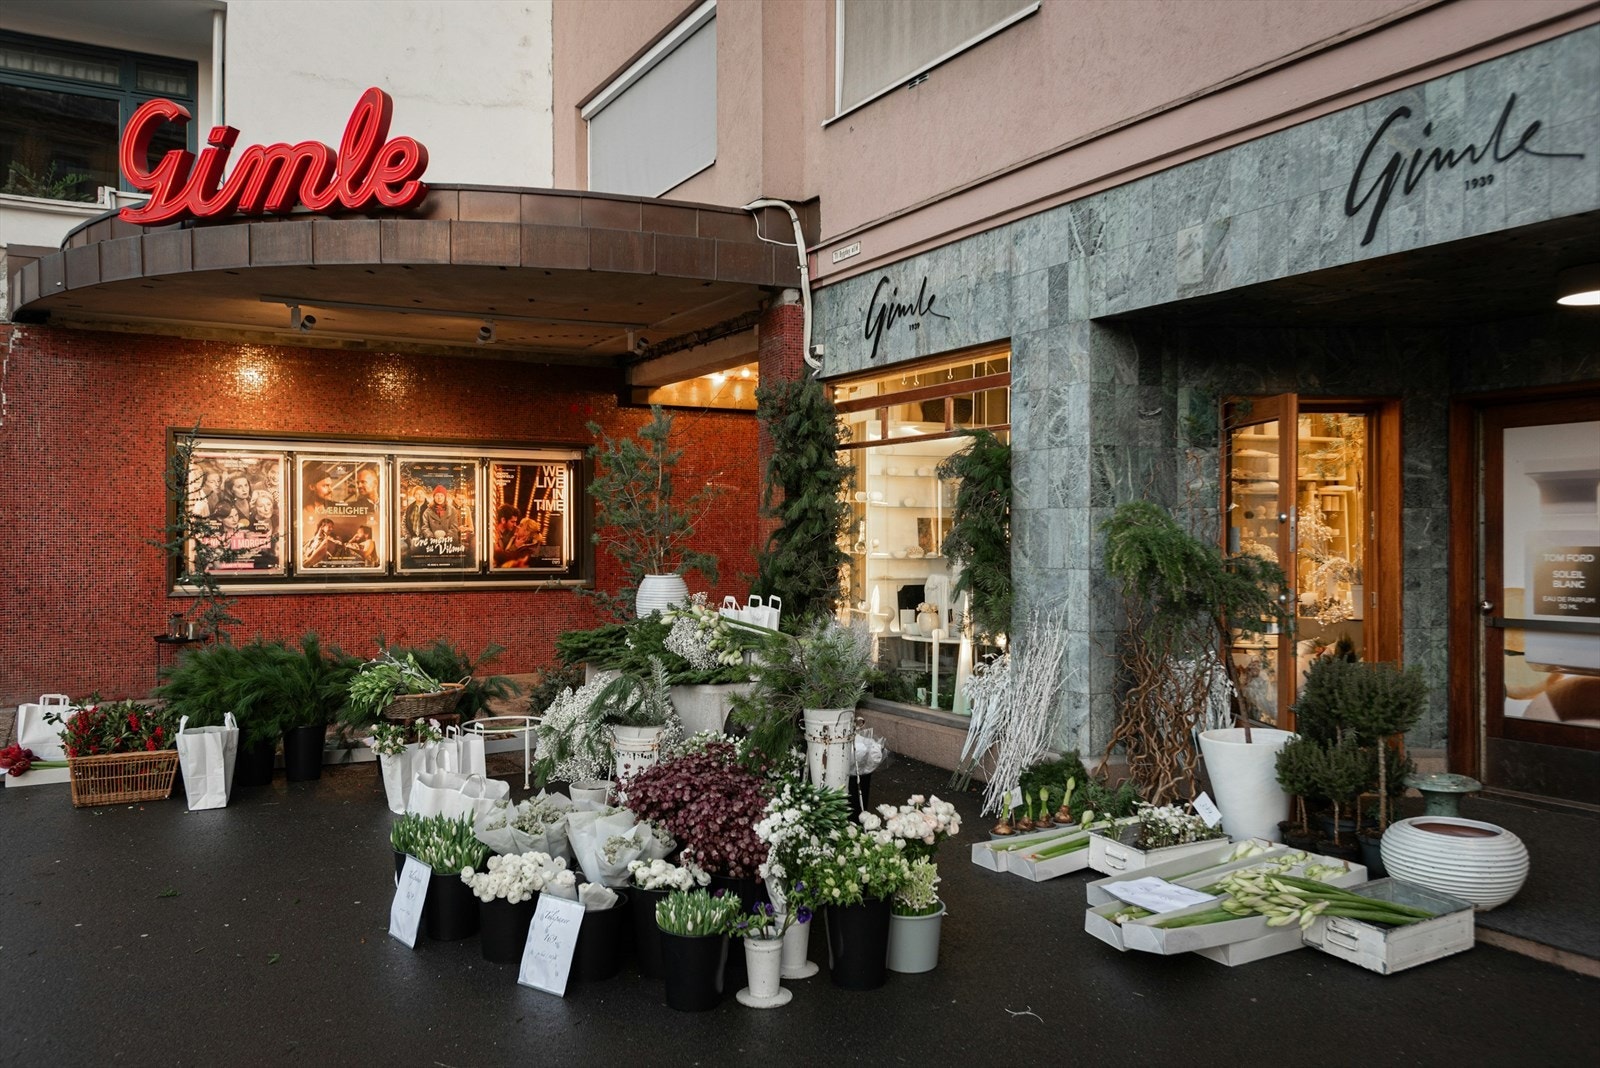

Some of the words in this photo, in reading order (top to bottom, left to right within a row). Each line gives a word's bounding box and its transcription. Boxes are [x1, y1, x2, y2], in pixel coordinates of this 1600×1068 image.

[118, 86, 430, 228] Gimle
[1344, 92, 1586, 248] Gimle
[1464, 174, 1494, 191] 1939
[864, 275, 950, 359] Gimle
[543, 465, 564, 477] WE
[536, 476, 564, 488] LIVE
[552, 488, 564, 500] IN
[534, 499, 564, 511] TIME
[1543, 553, 1565, 562] TOM
[1566, 553, 1596, 563] FORD
[1552, 570, 1586, 579] SOLEIL
[1552, 580, 1586, 589] BLANC
